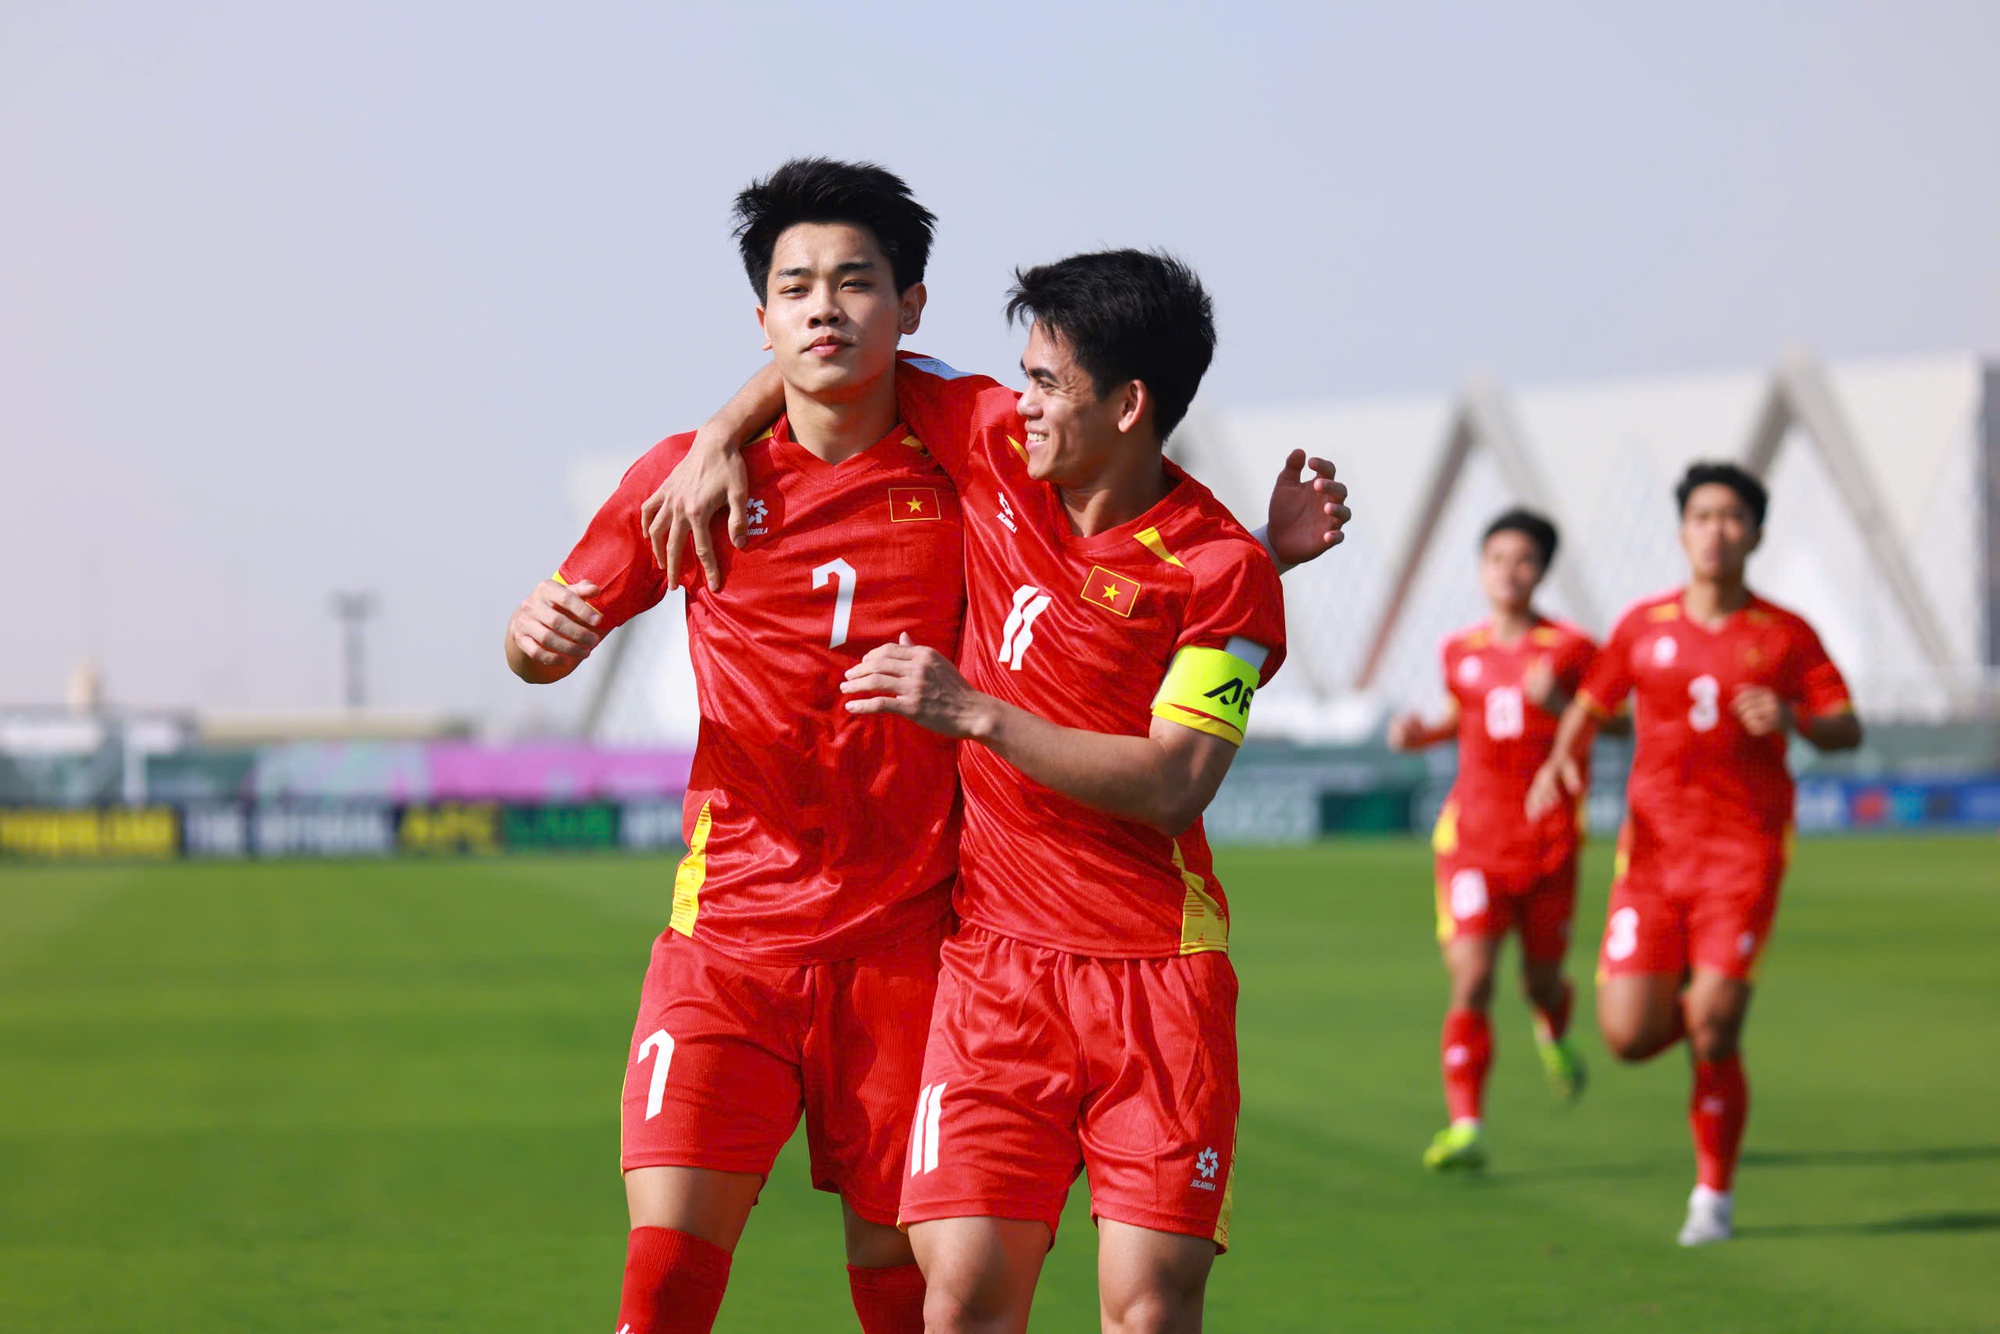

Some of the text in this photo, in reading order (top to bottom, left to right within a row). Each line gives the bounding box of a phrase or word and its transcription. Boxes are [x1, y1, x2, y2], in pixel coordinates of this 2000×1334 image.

[812, 557, 856, 649] 7
[998, 584, 1052, 670] 11
[1688, 673, 1720, 732] 3
[1606, 906, 1640, 961] 3
[637, 1028, 675, 1122] 7
[910, 1082, 947, 1178] 11
